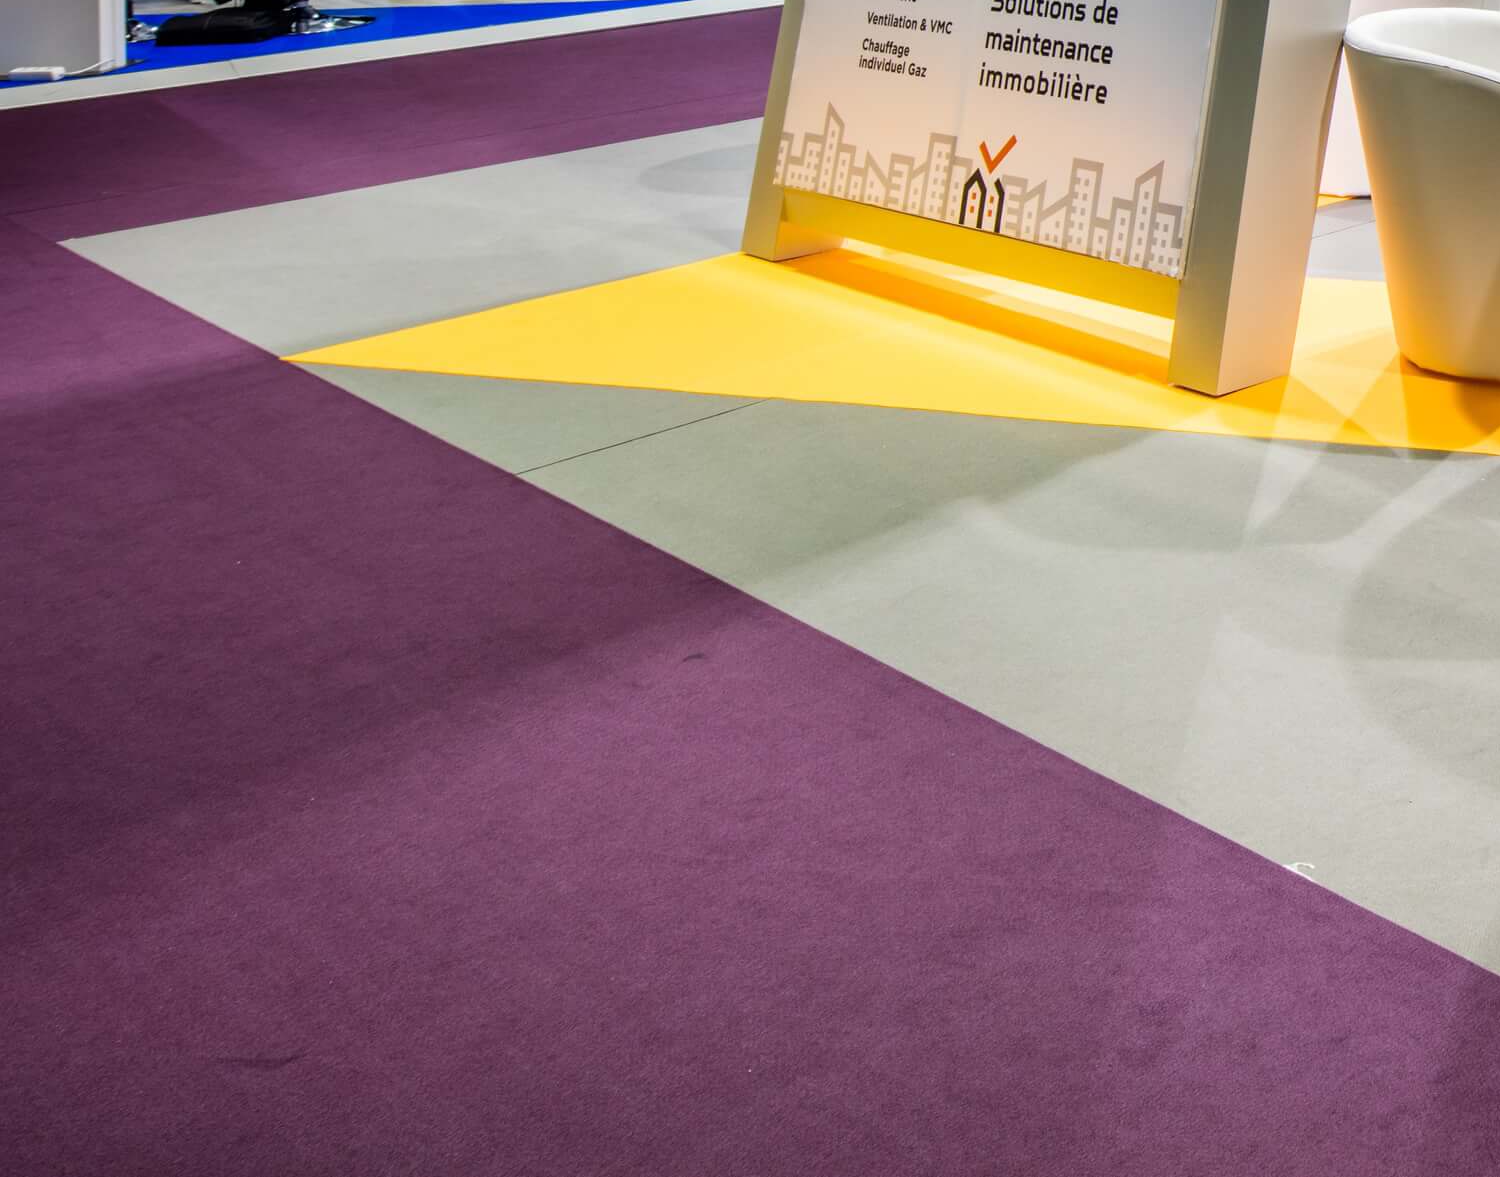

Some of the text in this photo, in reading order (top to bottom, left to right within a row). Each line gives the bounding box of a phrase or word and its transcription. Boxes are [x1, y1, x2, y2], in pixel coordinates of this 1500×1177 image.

[867, 11, 953, 35] Ventilation & VMC
[1093, 0, 1119, 25] de
[862, 38, 910, 59] Chauffage
[985, 28, 1114, 65] maintenance
[858, 55, 927, 78] individuel Gaz
[979, 62, 1108, 105] immobilière
